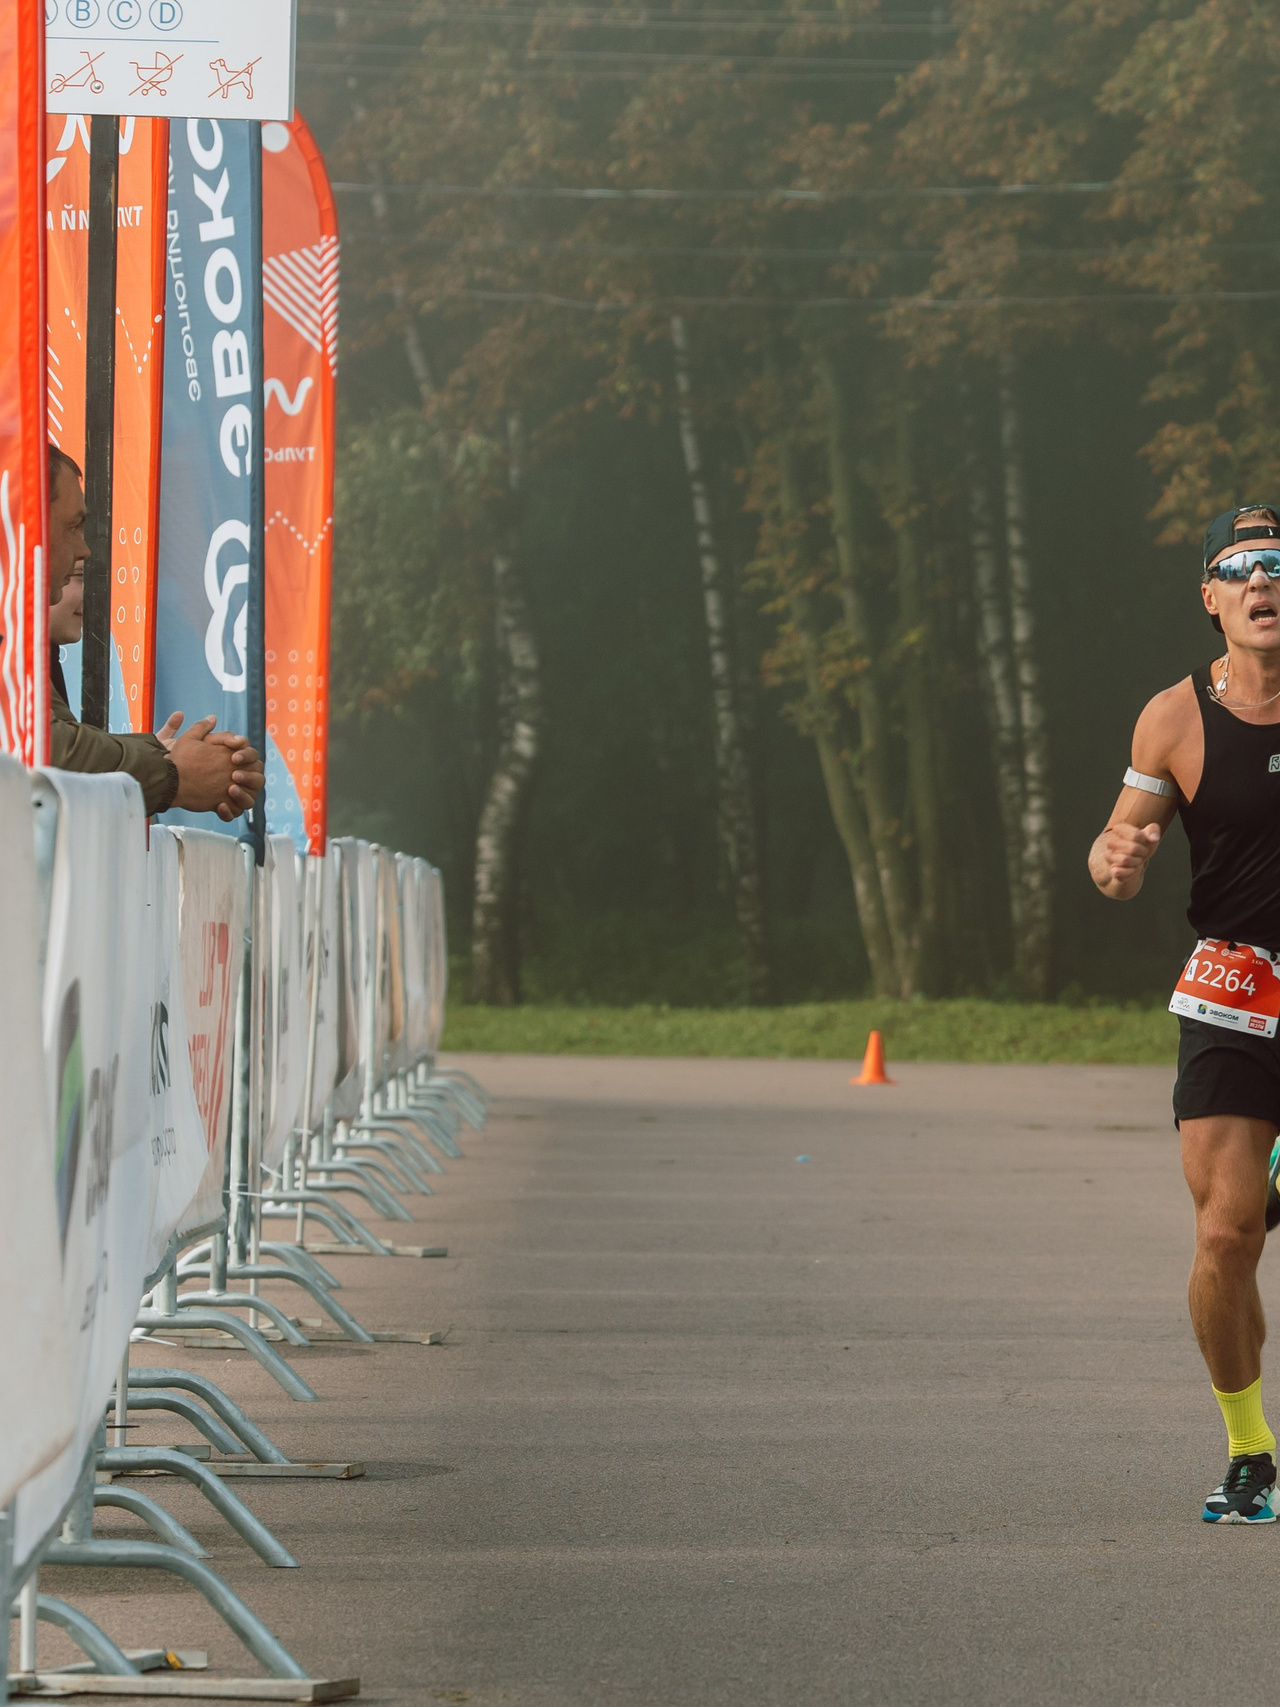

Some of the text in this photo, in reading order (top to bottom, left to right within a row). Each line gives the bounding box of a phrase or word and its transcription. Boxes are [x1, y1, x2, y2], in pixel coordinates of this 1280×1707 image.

[75, 0, 91, 21] B
[116, 1, 133, 23] C
[159, 2, 176, 24] D
[1196, 960, 1256, 996] 2264
[1208, 1009, 1239, 1021] ЭВОКОМ
